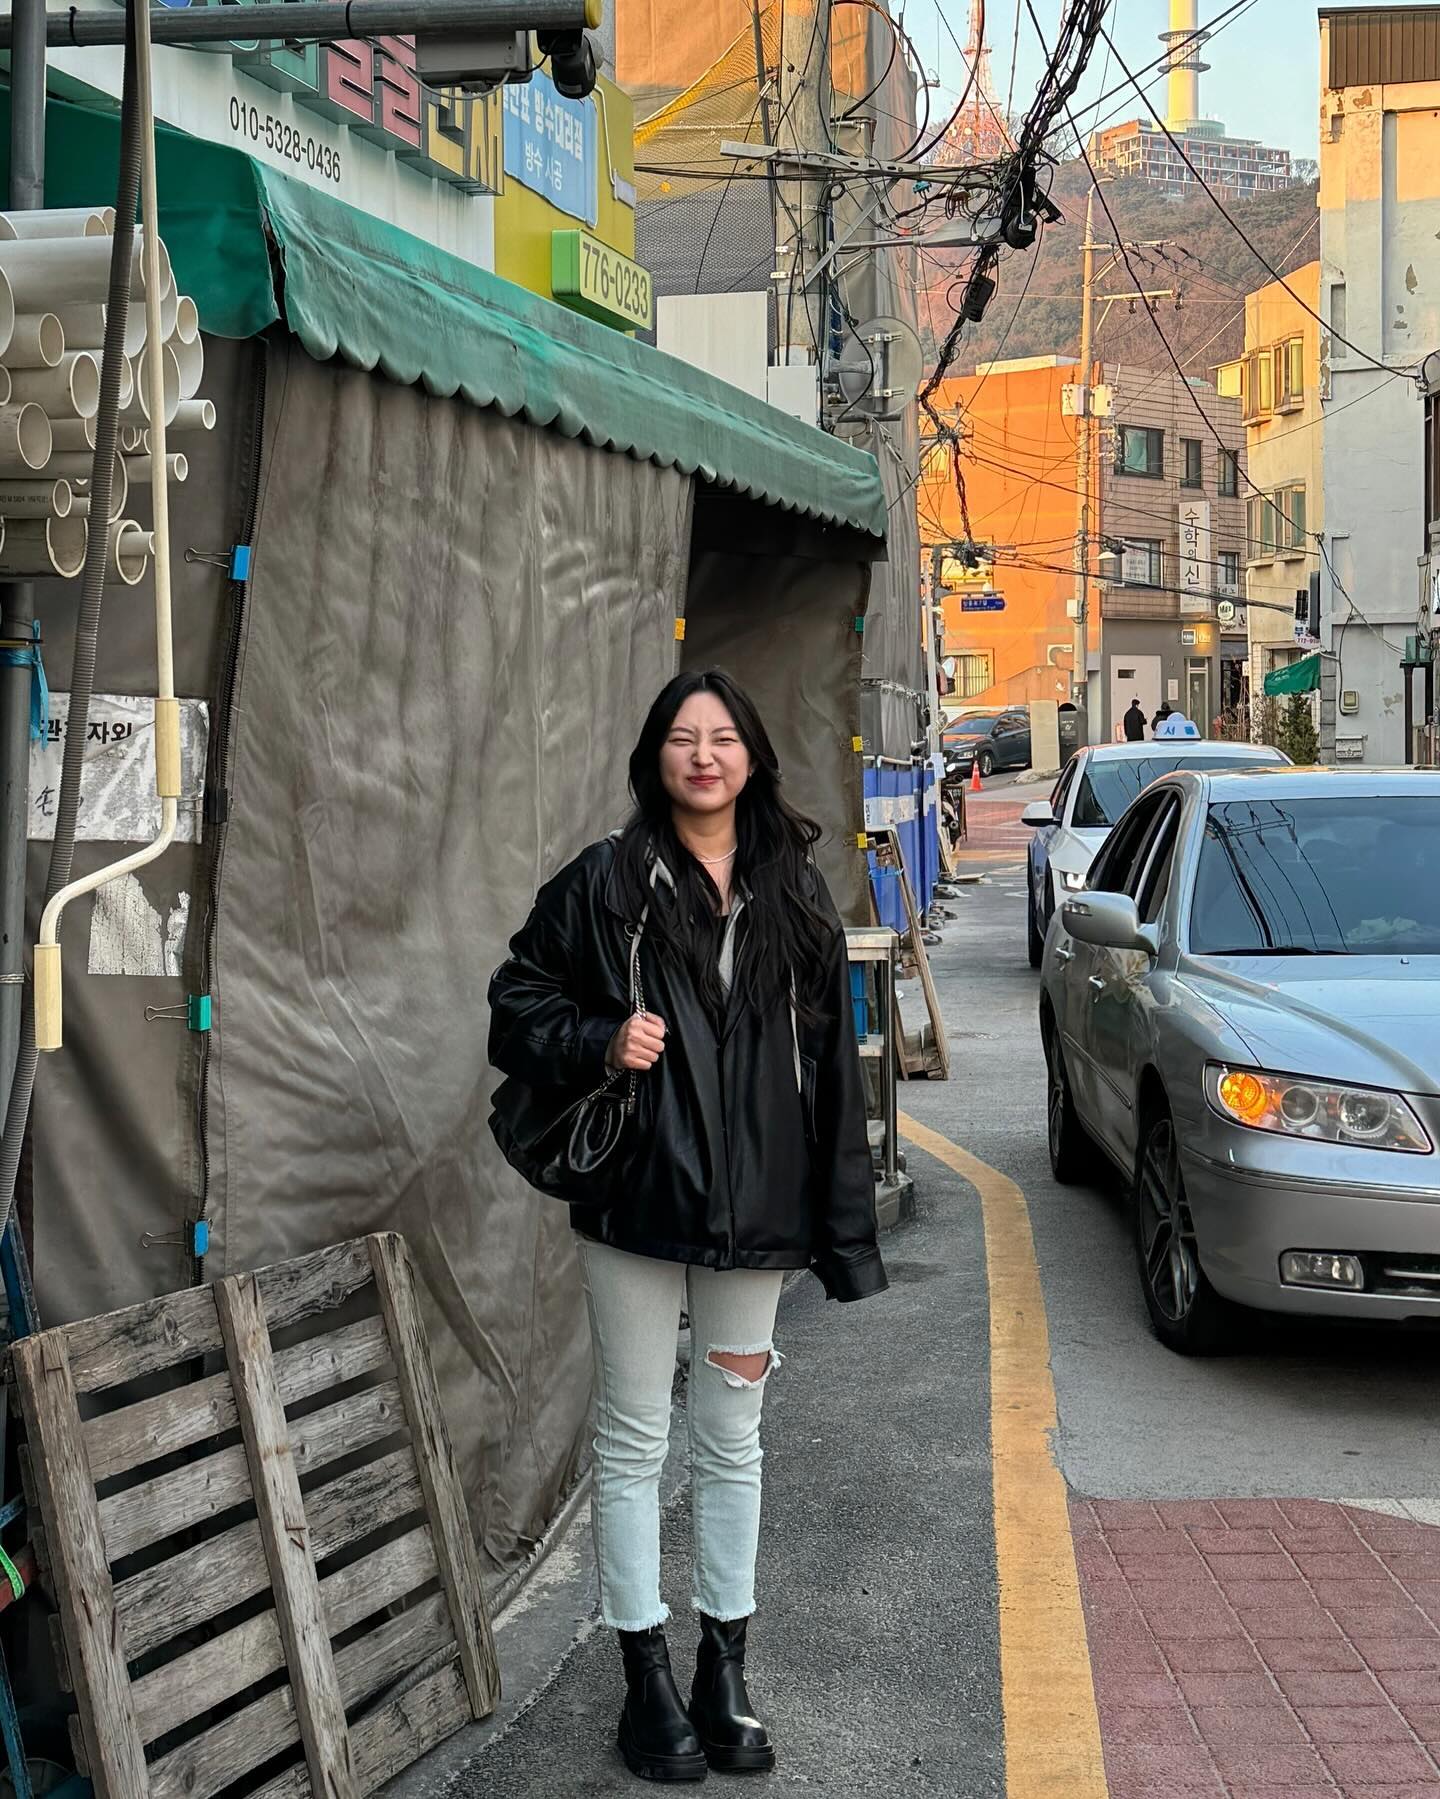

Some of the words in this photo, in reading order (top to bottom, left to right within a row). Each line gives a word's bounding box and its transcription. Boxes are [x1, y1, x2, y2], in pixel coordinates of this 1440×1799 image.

[230, 96, 341, 183] 010-5328-0436
[534, 88, 583, 161] 방수대리점
[525, 140, 543, 178] 방수
[544, 155, 563, 191] 시공
[583, 241, 648, 319] 776-0233
[40, 719, 133, 744] 관자외
